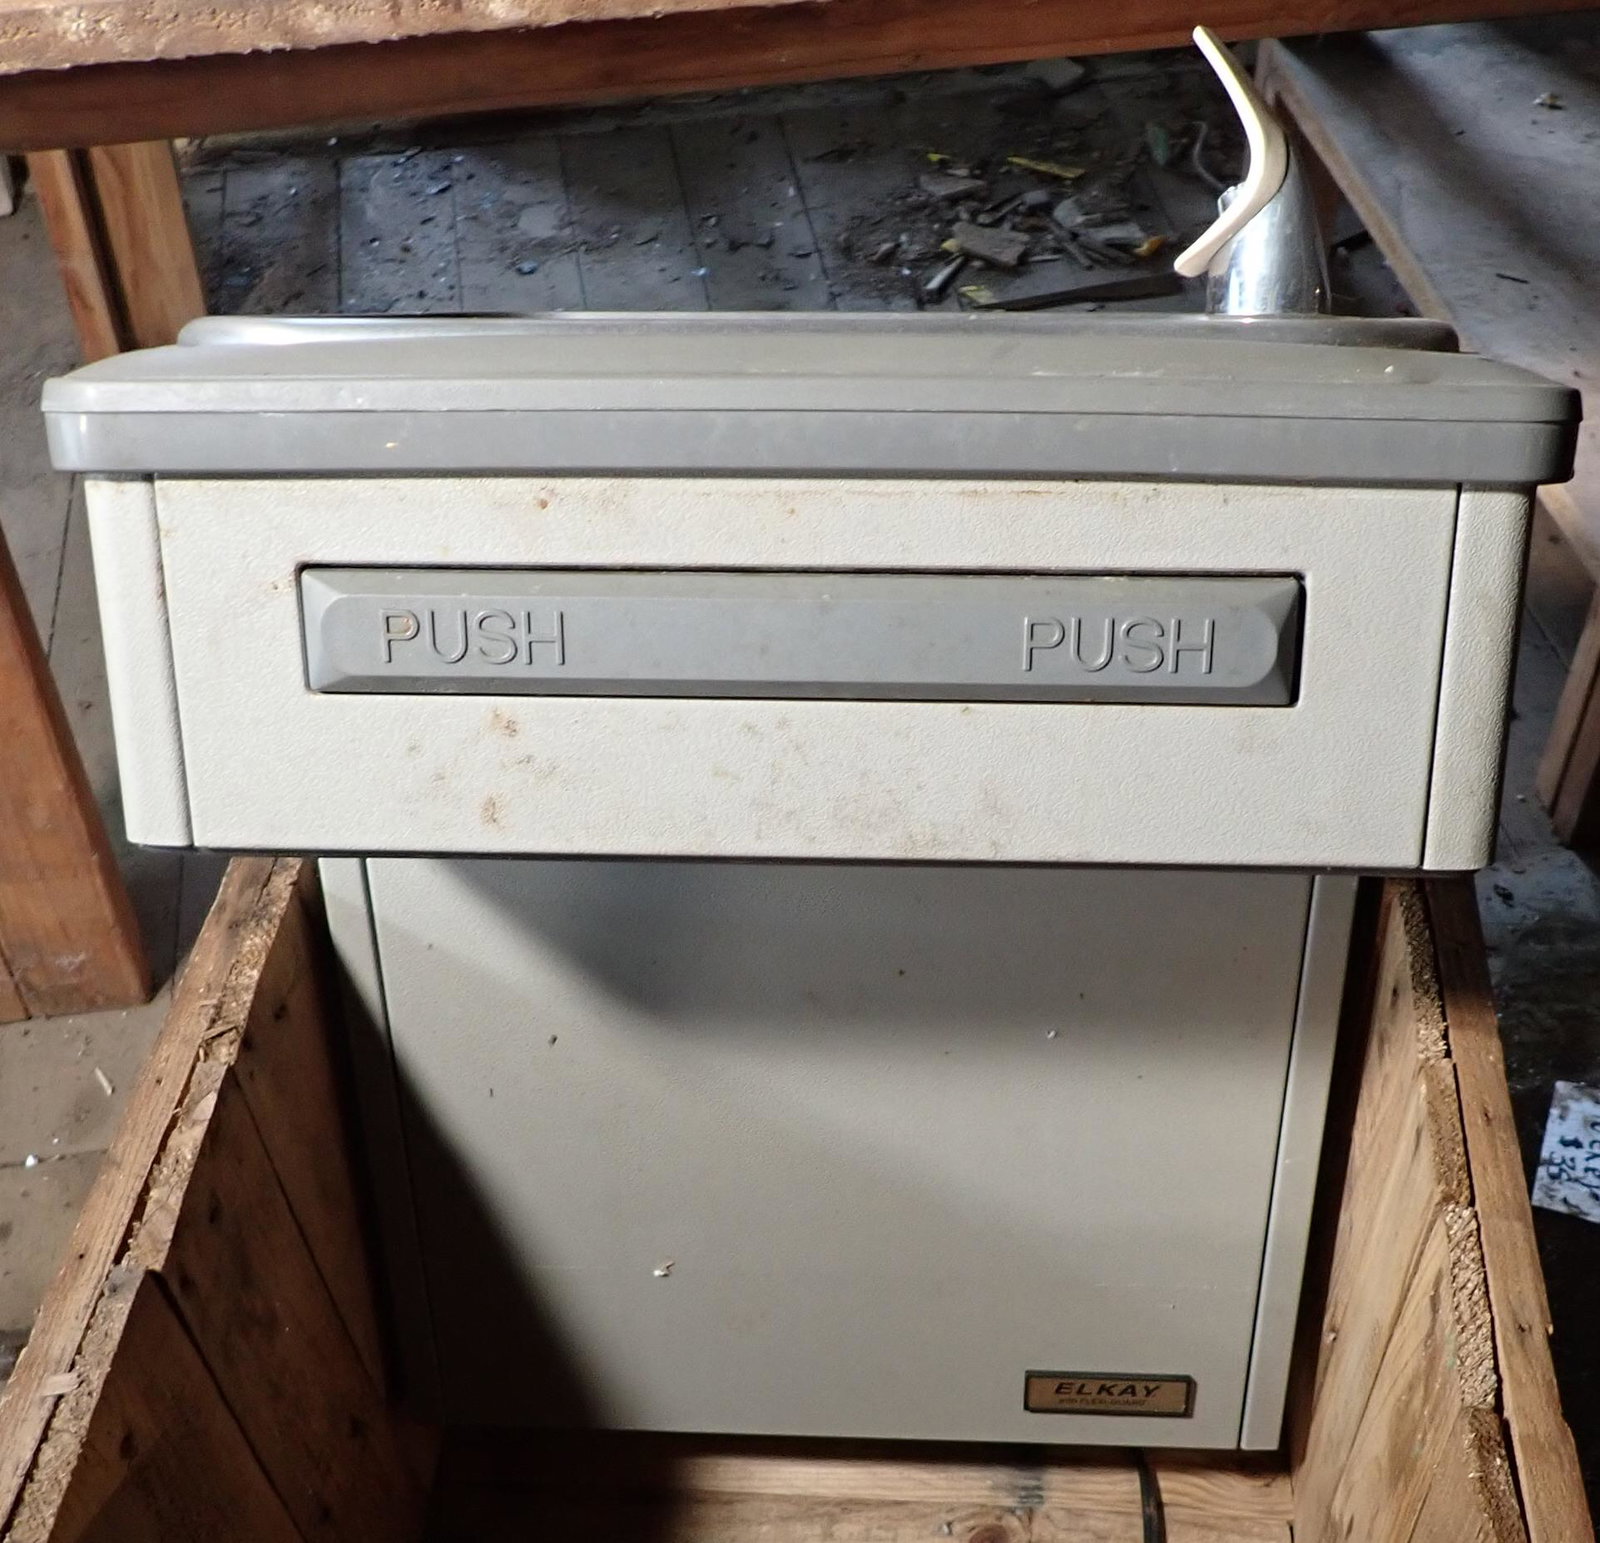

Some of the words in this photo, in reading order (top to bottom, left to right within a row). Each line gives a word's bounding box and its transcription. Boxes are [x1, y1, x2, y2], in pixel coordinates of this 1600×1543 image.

[380, 607, 565, 666] PUSH
[1022, 616, 1216, 674] PUSH
[1054, 1378, 1162, 1398] ELKAY
